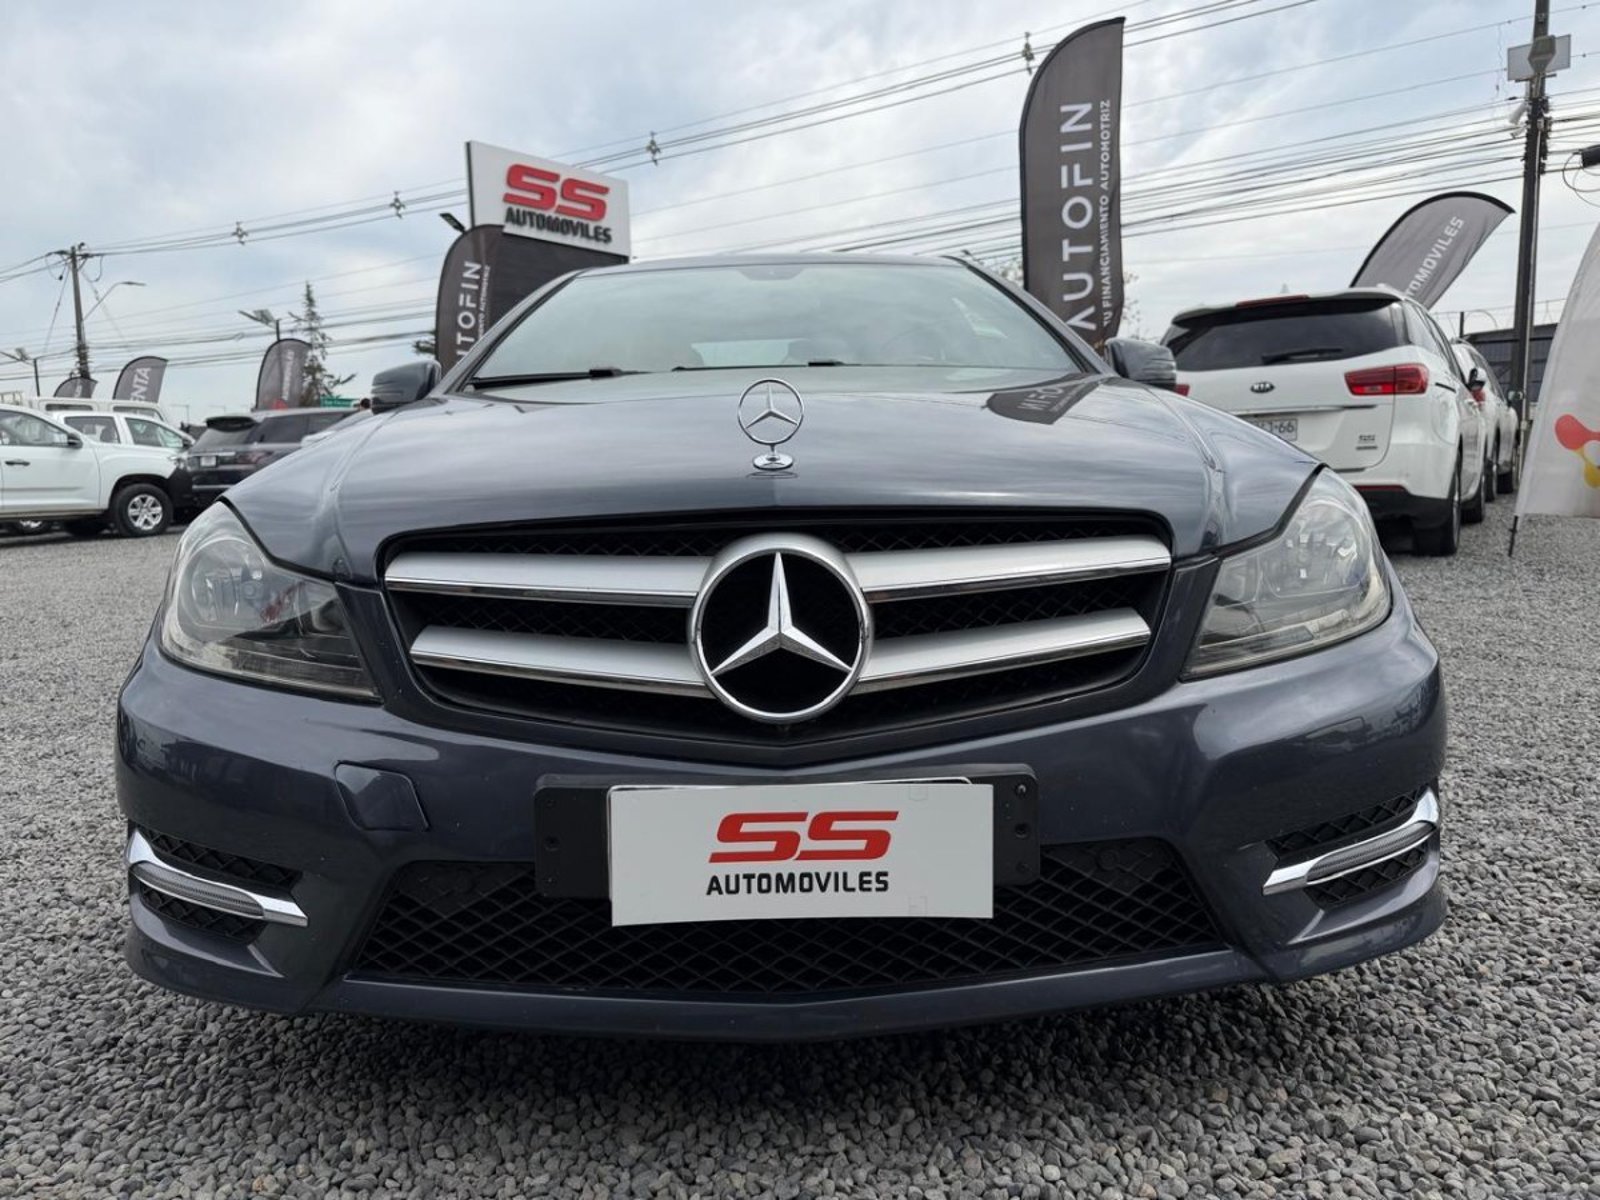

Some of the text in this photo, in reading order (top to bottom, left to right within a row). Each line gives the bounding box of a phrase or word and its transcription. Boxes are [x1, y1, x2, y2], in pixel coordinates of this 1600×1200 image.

[1100, 99, 1111, 190] AUTOMOTRIZ
[503, 163, 610, 223] SS
[1060, 102, 1096, 331] AUTOFIN
[504, 206, 613, 244] AUTOMOVILES
[1100, 195, 1113, 308] FINANCIAMIENTO
[1405, 216, 1465, 297] TOMOVILES
[1252, 382, 1272, 391] KIA
[708, 810, 899, 864] SS
[706, 871, 890, 896] AUTOMOVILES
